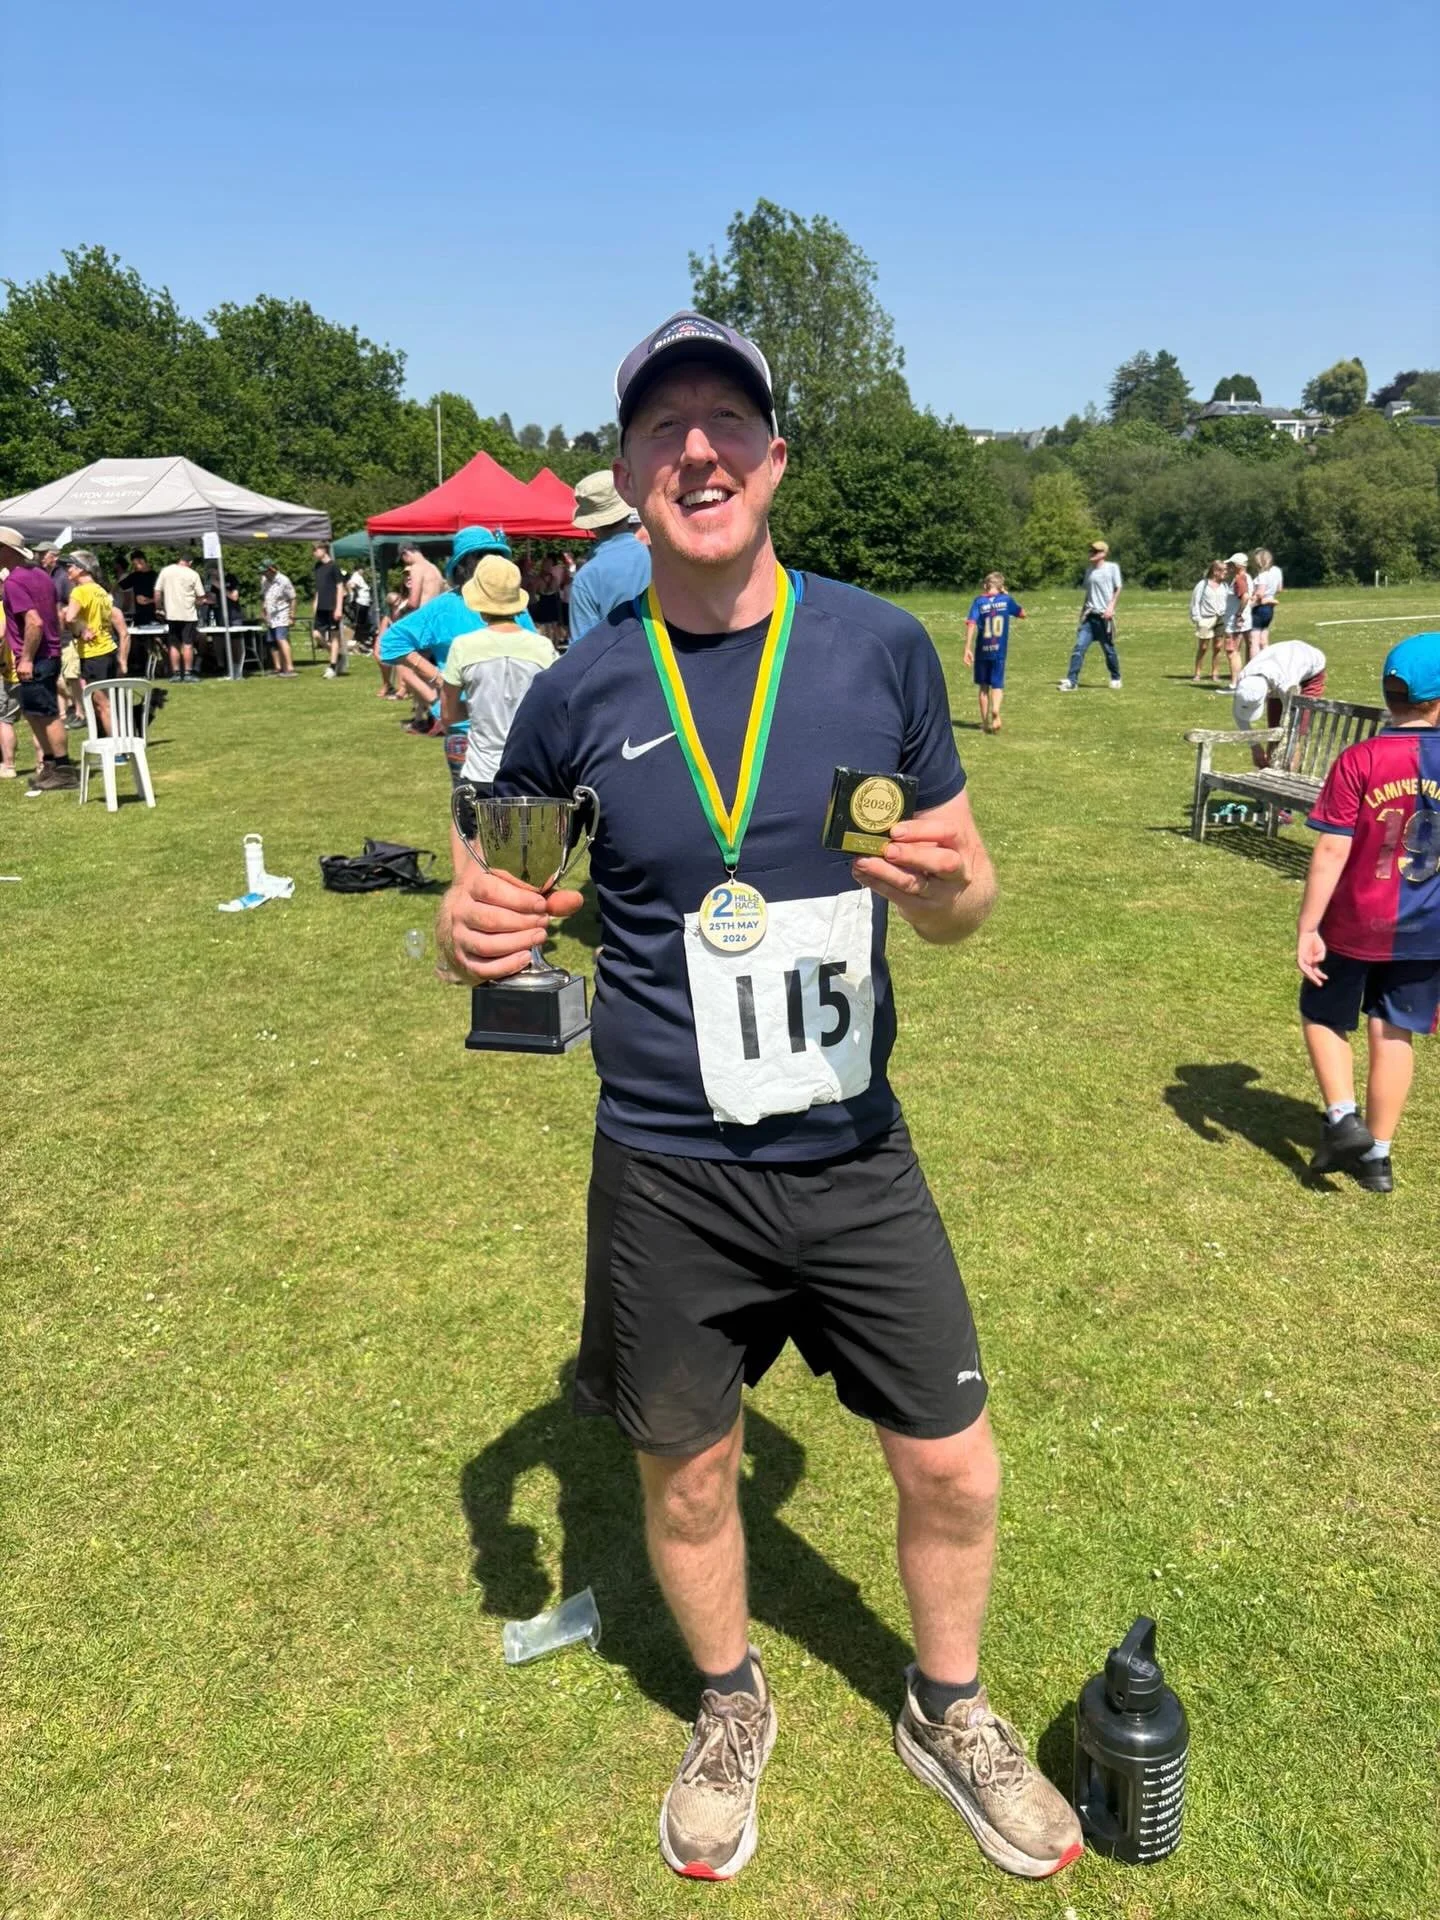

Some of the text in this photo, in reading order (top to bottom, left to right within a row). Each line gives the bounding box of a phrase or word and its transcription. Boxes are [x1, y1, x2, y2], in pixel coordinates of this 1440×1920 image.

[983, 615, 1004, 638] 10
[863, 798, 891, 811] 2026
[1375, 808, 1440, 882] 19
[712, 888, 760, 917] 2 HILLS
[735, 902, 760, 910] RACE
[709, 921, 759, 931] 25TH MAY
[723, 935, 747, 943] 2026
[736, 961, 850, 1060] 115
